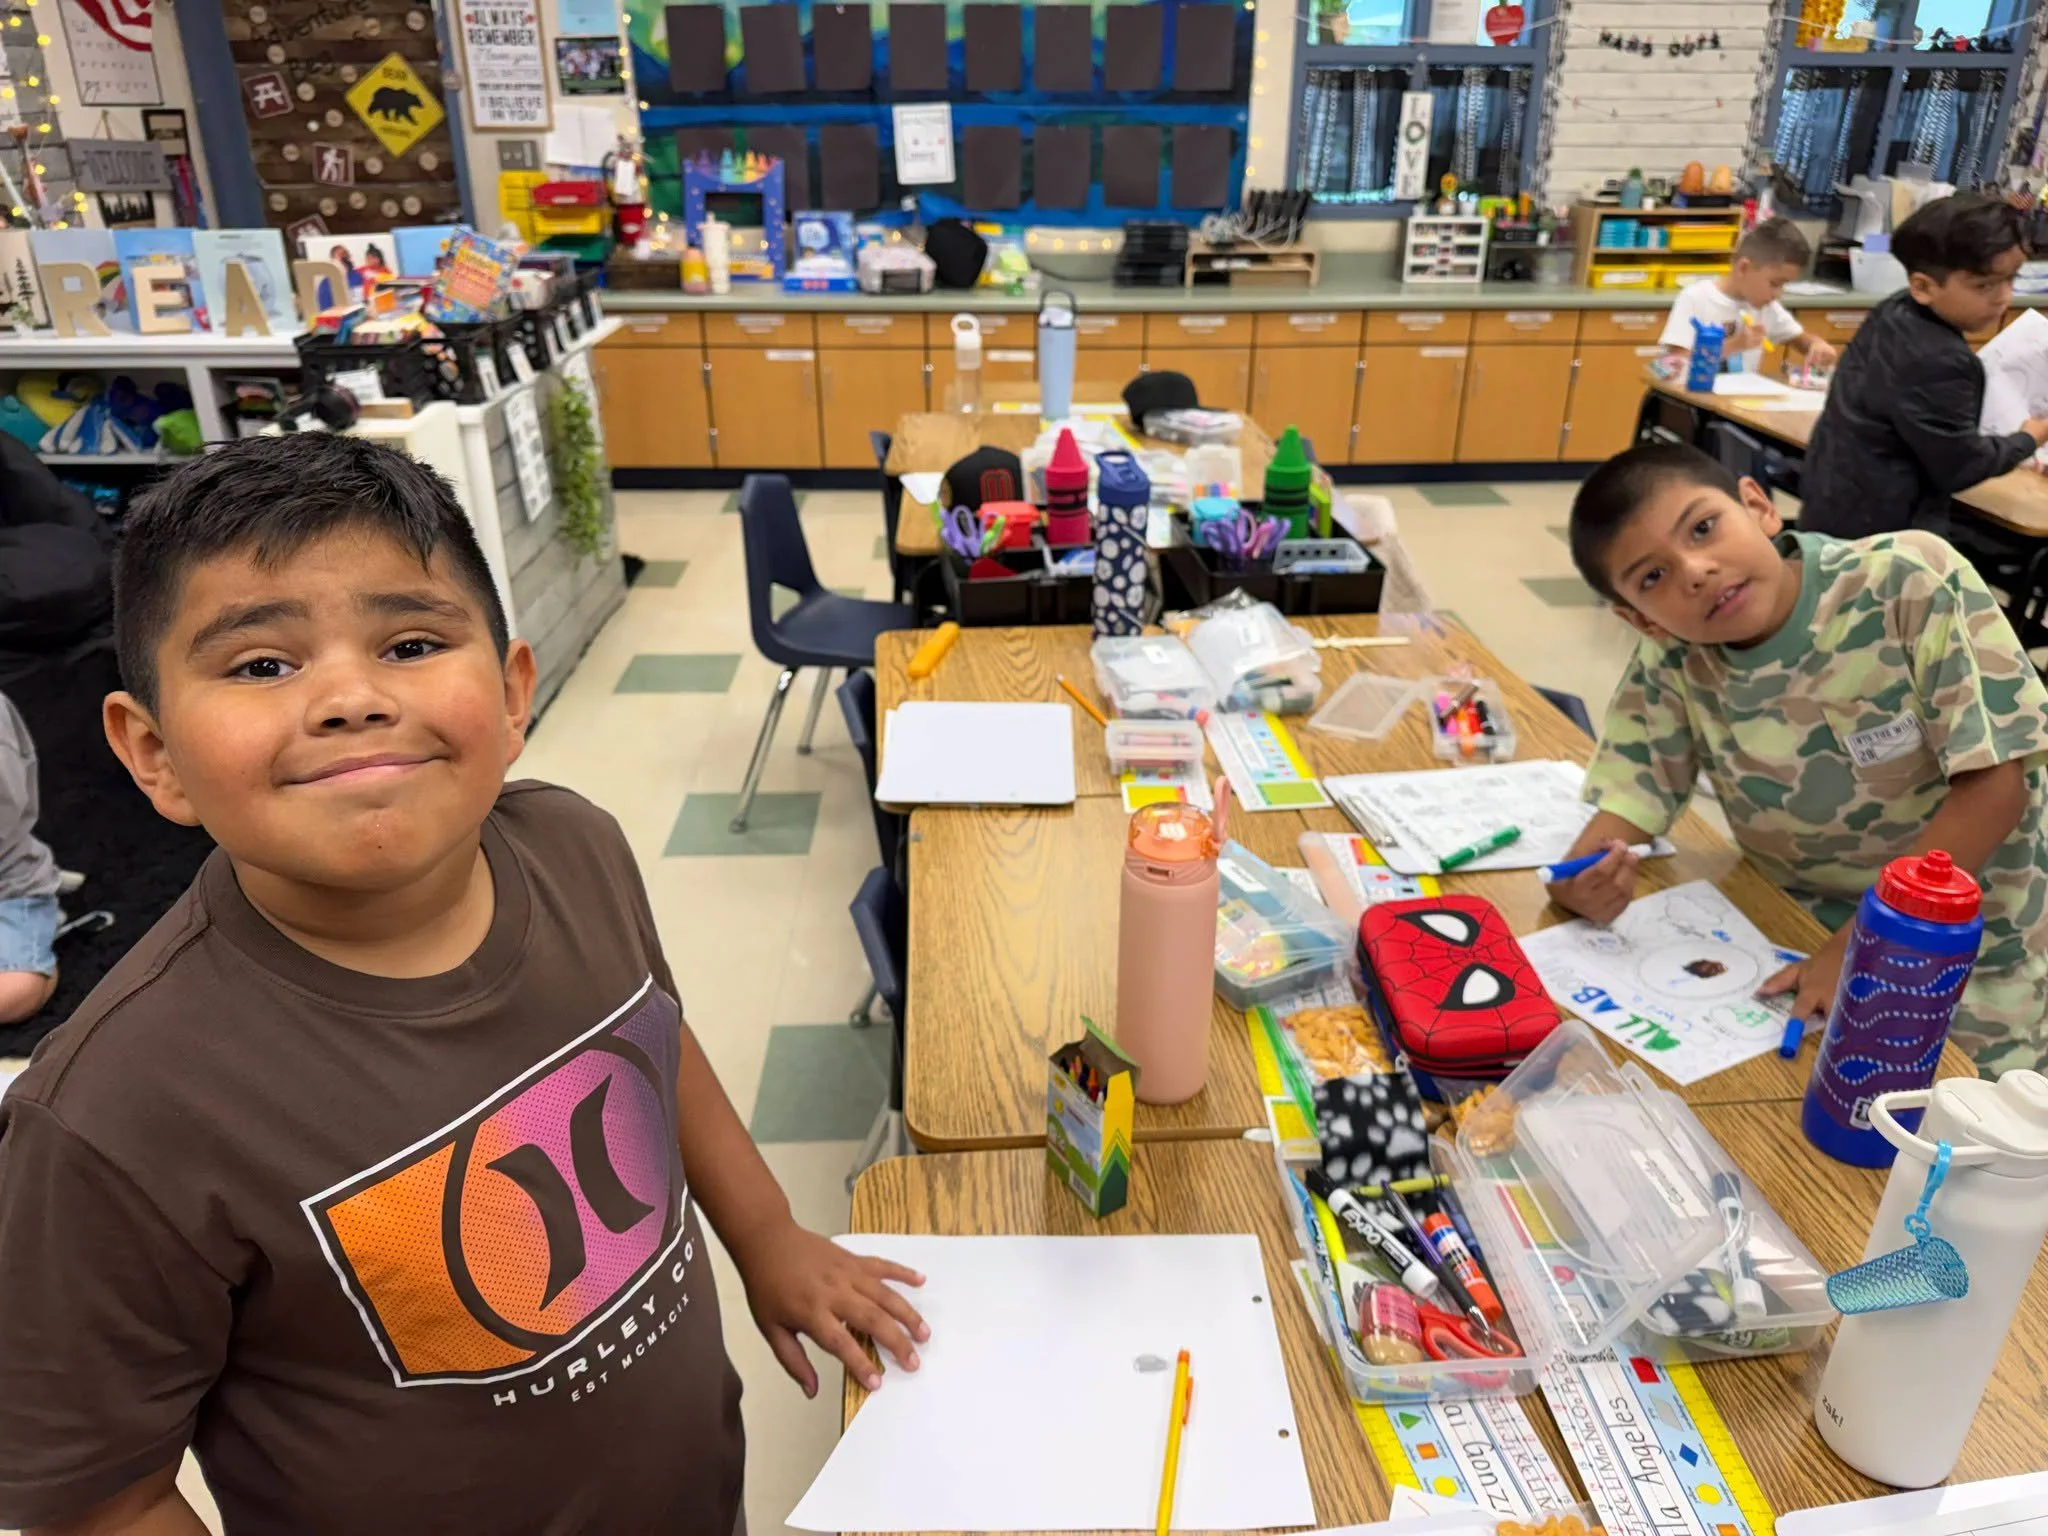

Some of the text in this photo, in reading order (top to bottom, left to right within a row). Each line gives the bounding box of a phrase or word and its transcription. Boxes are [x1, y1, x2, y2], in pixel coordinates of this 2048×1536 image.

[468, 29, 536, 46] REMEMBER
[493, 1294, 656, 1407] HURLEY
[571, 1293, 690, 1402] EST MCMXCIX
[1608, 1396, 1665, 1486] Angeles
